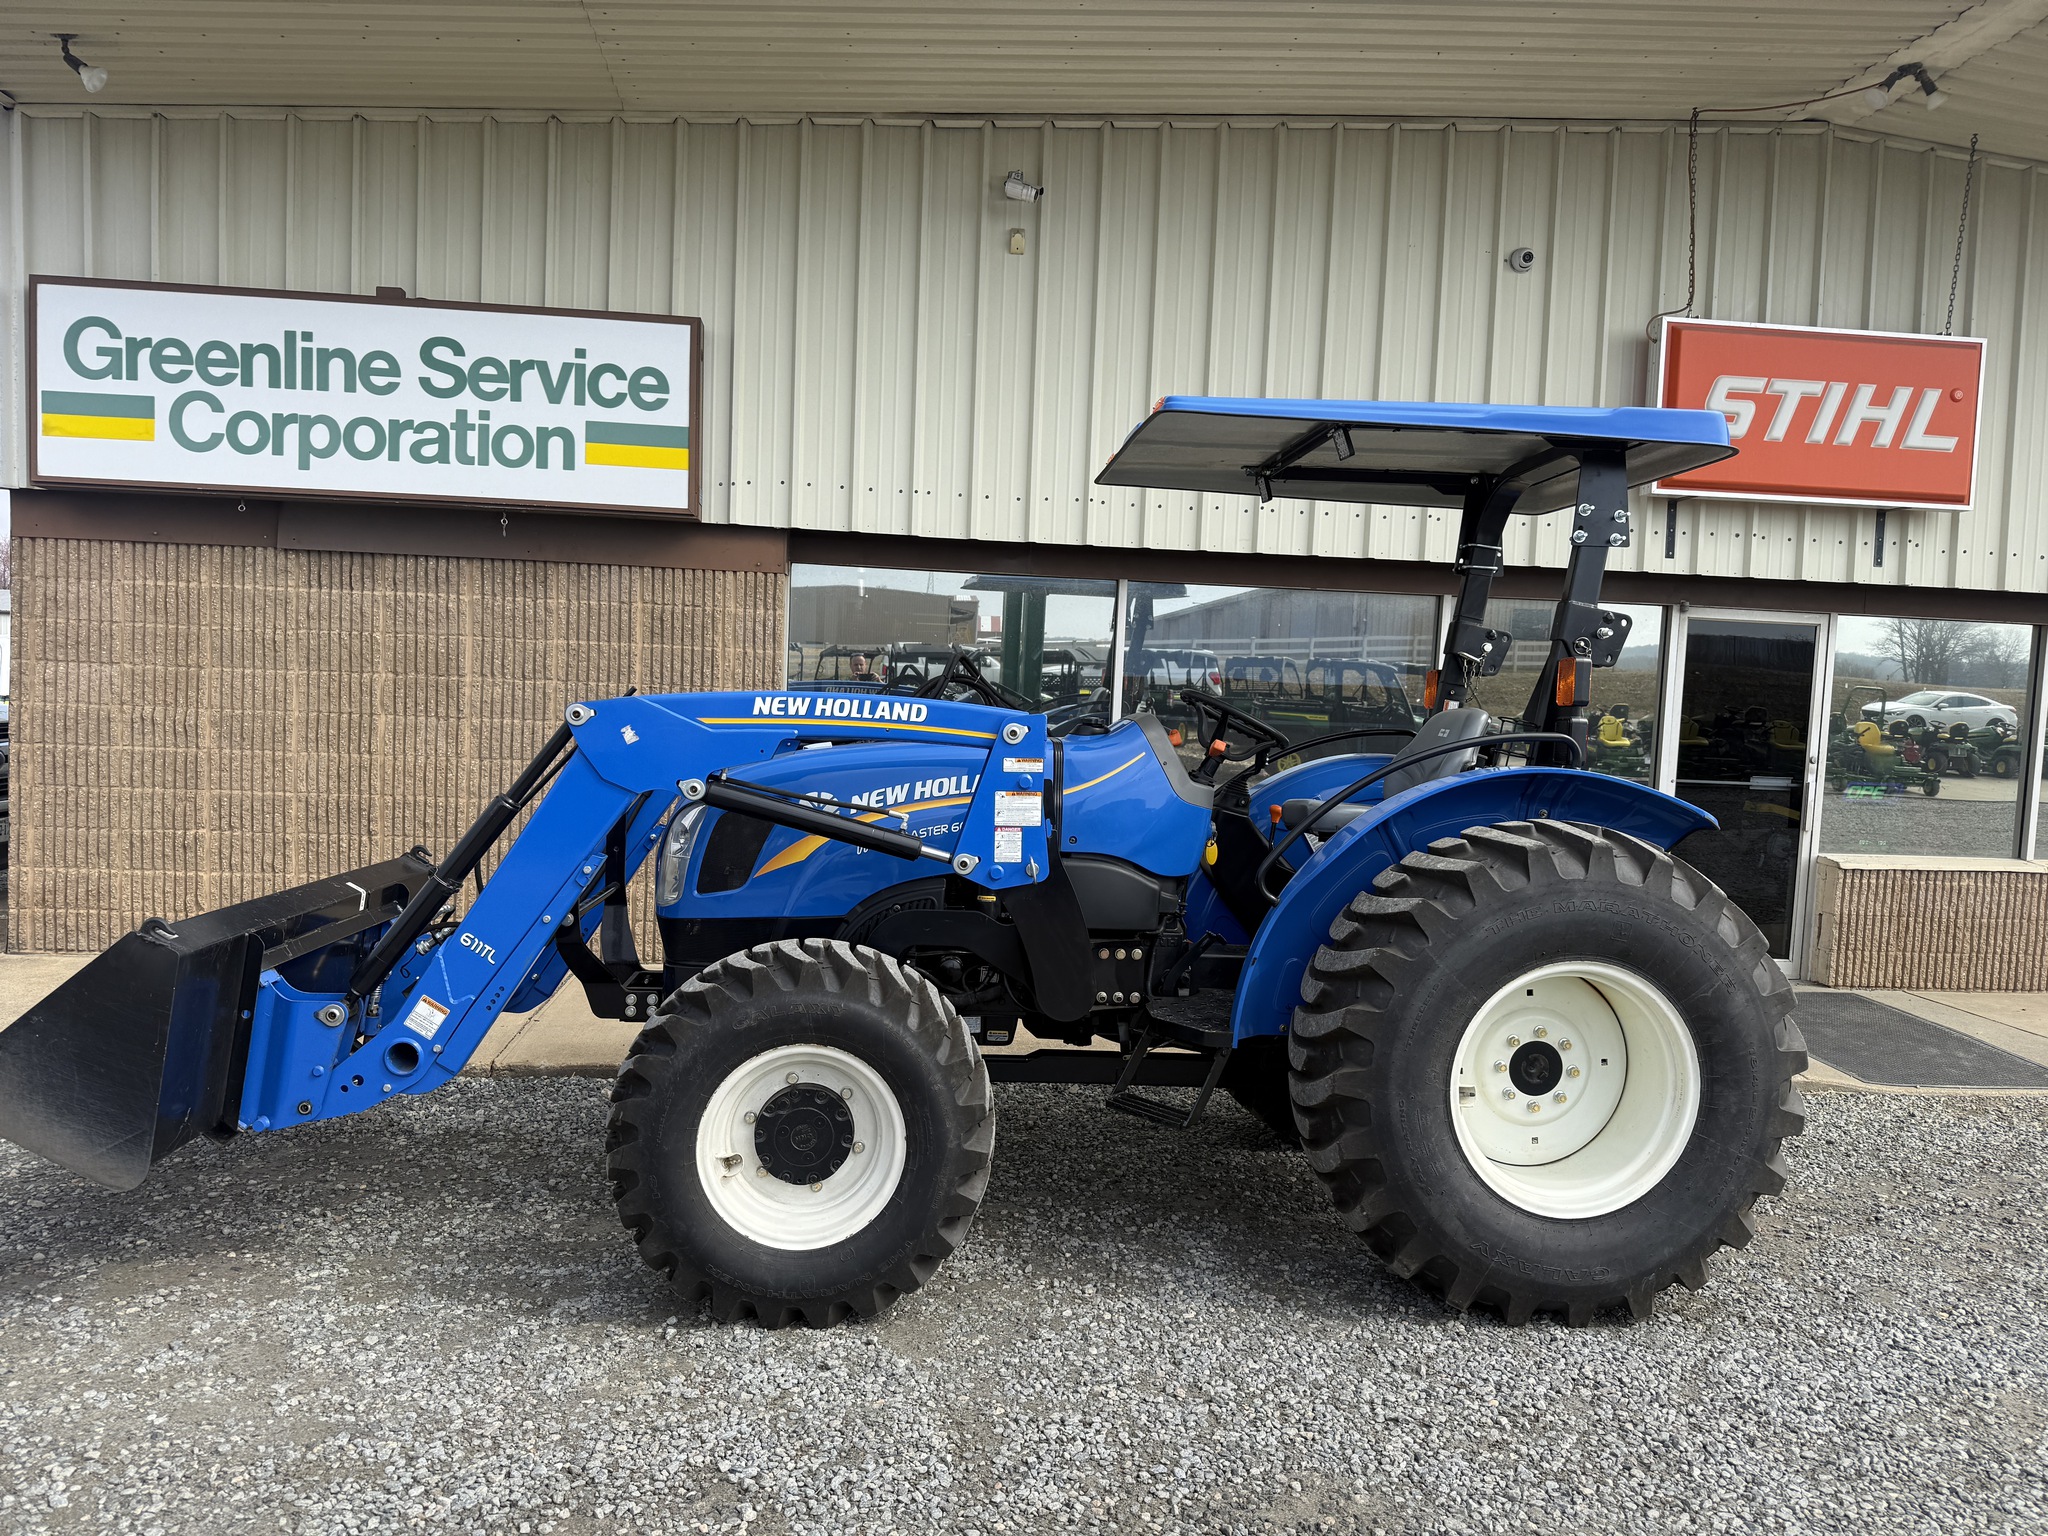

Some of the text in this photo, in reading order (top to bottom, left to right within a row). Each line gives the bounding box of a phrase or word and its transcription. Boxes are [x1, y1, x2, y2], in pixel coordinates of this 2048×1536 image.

[63, 316, 670, 412] Greenline Service
[1705, 375, 1959, 452] STIHL
[168, 390, 576, 471] Corporation
[752, 696, 928, 723] NEW HOLLAND
[850, 783, 910, 814] NEW
[905, 824, 949, 838] ASTER
[460, 932, 496, 965] 611TL
